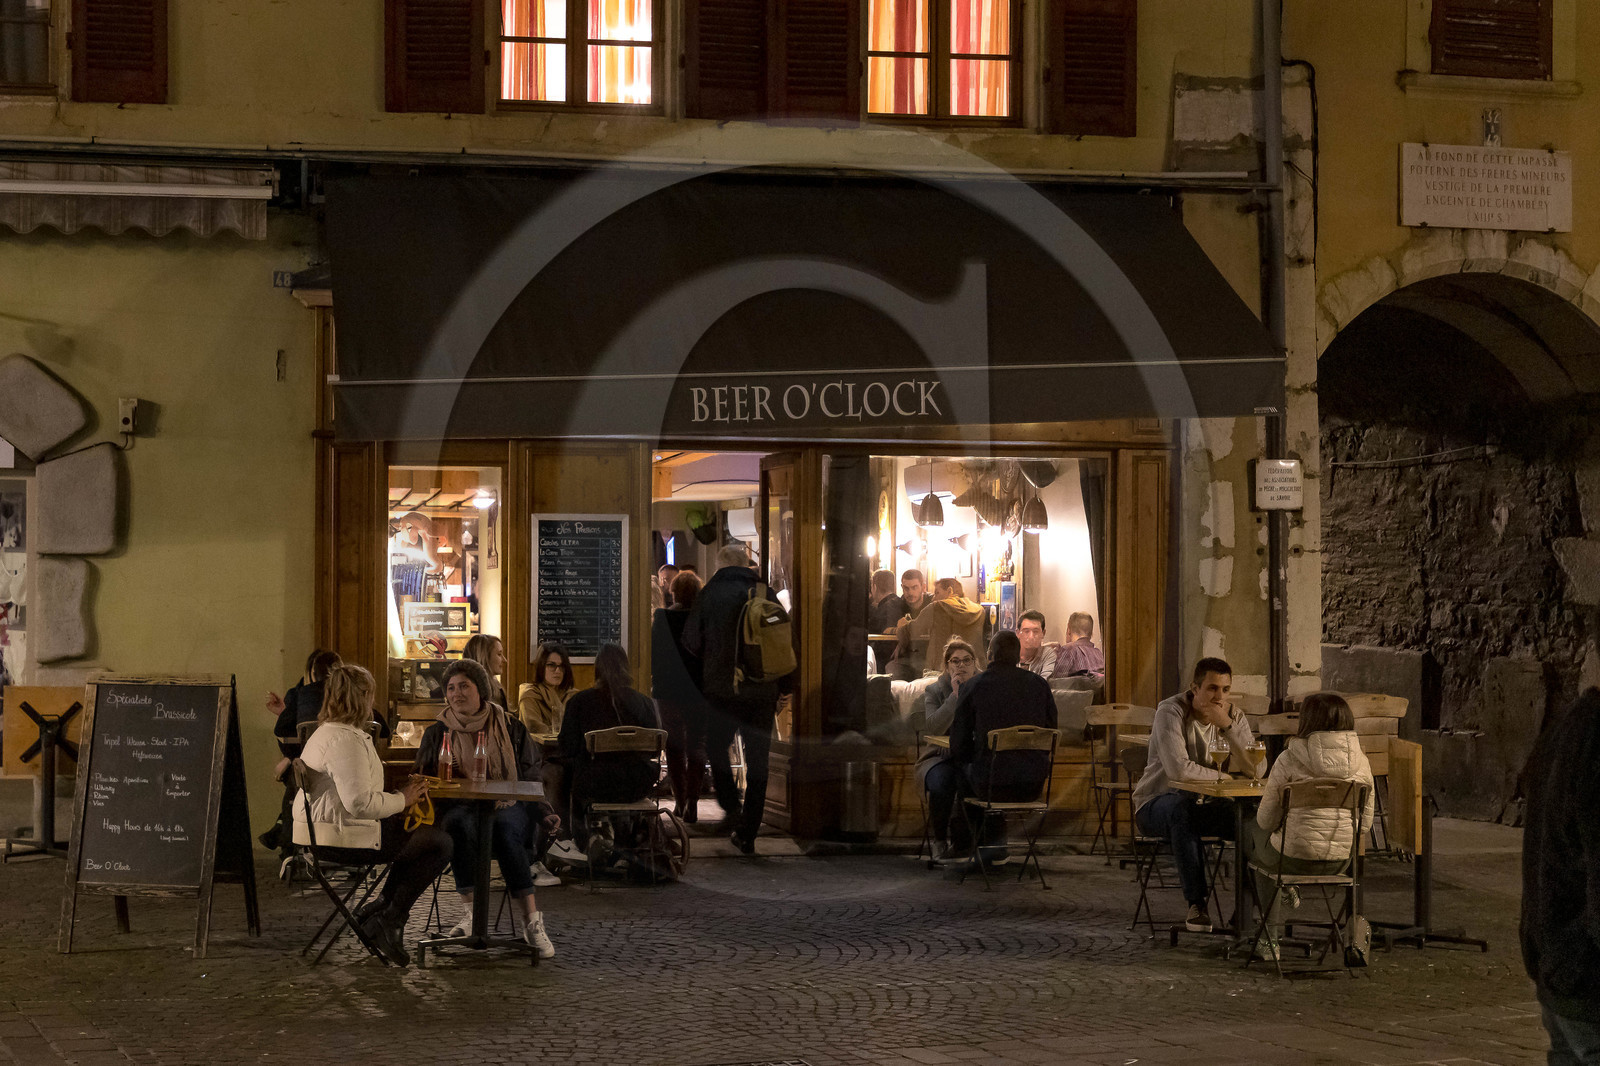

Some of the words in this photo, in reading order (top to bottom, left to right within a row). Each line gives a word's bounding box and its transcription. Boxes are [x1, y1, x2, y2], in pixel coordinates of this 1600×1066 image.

[1435, 151, 1463, 163] FOND
[1466, 152, 1479, 164] DE
[1482, 153, 1513, 165] CETTE
[1517, 155, 1559, 168] IMPASSE
[1410, 164, 1456, 177] POTERNE
[1459, 166, 1478, 178] DES
[1521, 171, 1566, 183] MINEURS
[1424, 180, 1467, 192] VESTIGE
[1470, 182, 1483, 193] DE
[1486, 183, 1499, 194] LA
[1426, 194, 1476, 207] ENCEINTE
[1479, 196, 1492, 207] DE
[689, 384, 776, 424] BEER
[782, 379, 943, 423] O'CLOCK
[103, 817, 121, 835] Happy
[84, 858, 103, 870] Beer
